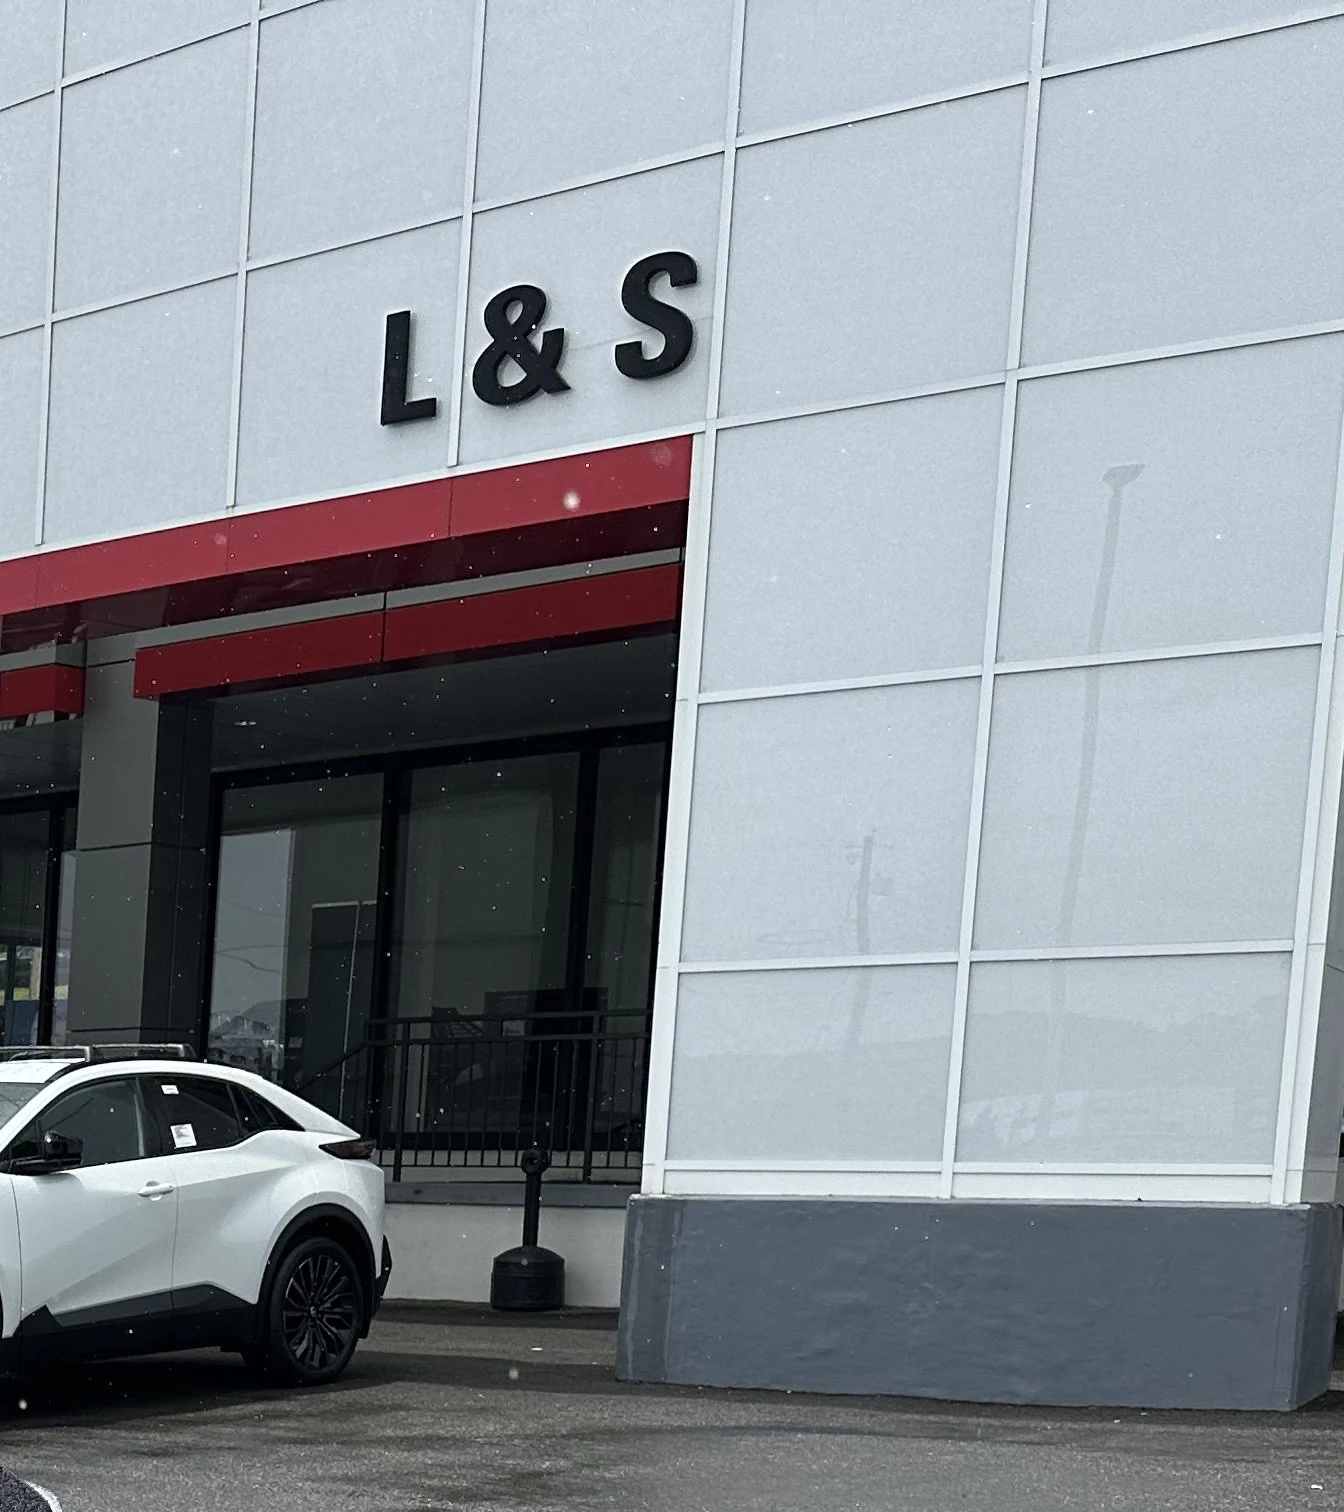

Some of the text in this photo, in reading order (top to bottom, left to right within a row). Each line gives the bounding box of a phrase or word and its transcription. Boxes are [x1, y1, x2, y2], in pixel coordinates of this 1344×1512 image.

[380, 250, 698, 426] L & S
